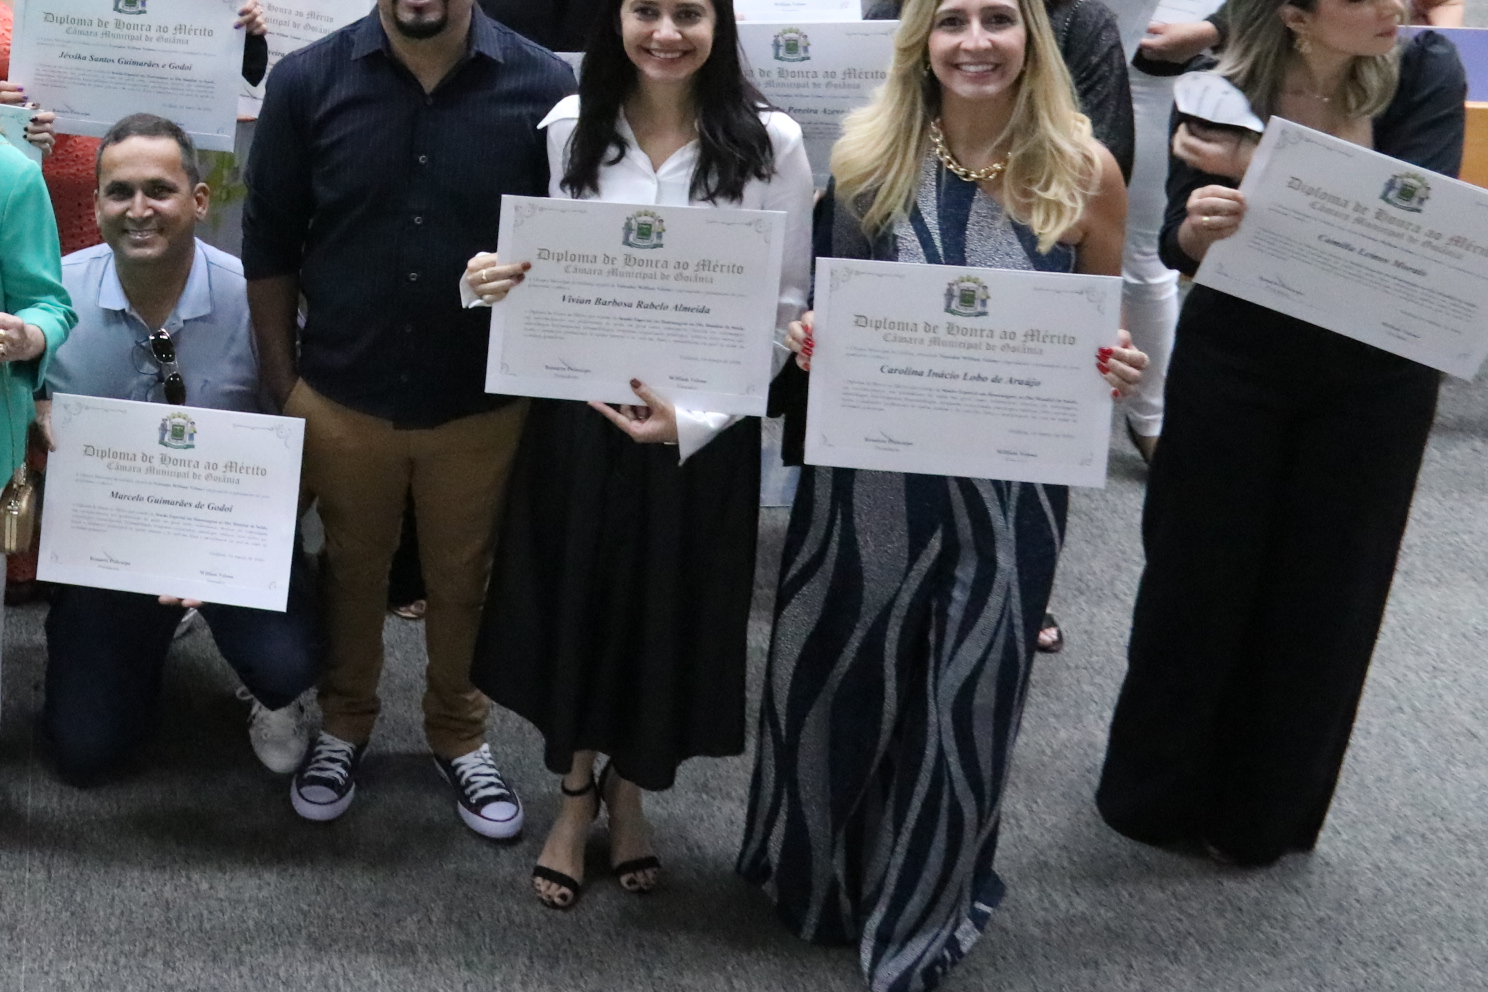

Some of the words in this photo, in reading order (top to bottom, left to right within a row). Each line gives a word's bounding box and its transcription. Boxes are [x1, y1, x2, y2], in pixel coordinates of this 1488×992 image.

[42, 11, 92, 28] Diploma
[95, 17, 108, 28] de
[112, 18, 150, 32] Honra
[154, 24, 167, 33] ao
[172, 23, 214, 39] Mérito
[536, 247, 597, 265] Diploma
[601, 253, 617, 265] de
[622, 253, 668, 269] Honra
[672, 260, 688, 270] ao
[693, 258, 744, 275] Mérito
[853, 314, 918, 333] Diploma
[922, 321, 939, 334] de
[944, 322, 993, 339] Honra
[998, 329, 1016, 340] ao
[1022, 328, 1076, 346] Mérito
[82, 444, 137, 463] Diploma
[140, 451, 154, 463] de
[158, 452, 199, 469] Honra
[203, 460, 217, 471] ao
[222, 459, 267, 477] Mérito
